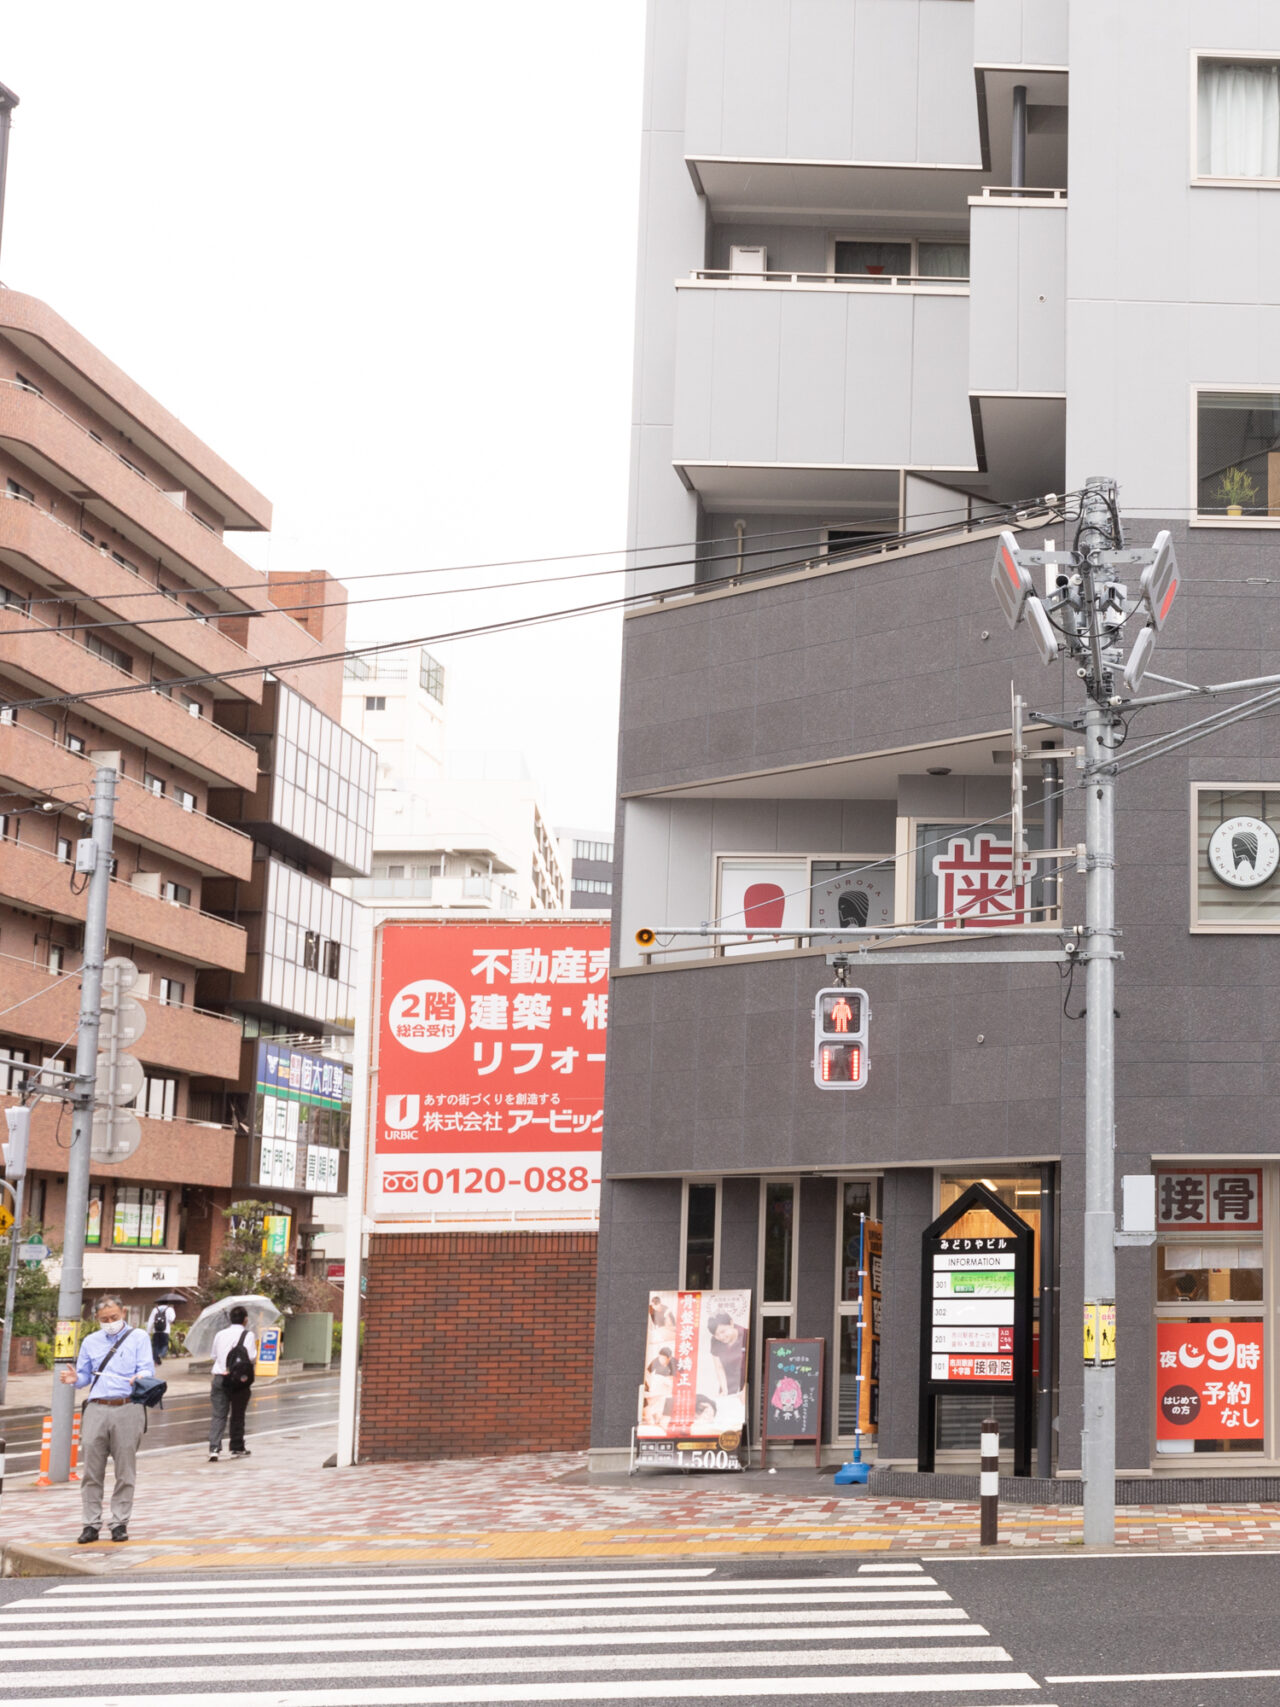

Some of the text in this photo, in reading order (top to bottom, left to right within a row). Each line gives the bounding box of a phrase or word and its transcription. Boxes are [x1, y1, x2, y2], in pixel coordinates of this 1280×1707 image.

[1221, 821, 1269, 838] AURORA
[1215, 847, 1275, 881] DENTAL CLINIC
[826, 880, 881, 897] AURORA
[938, 839, 1031, 929] 歯
[401, 992, 456, 1021] 2階
[396, 1024, 456, 1038] 総合受付
[424, 1093, 560, 1105] あすの街づくりを創造する
[423, 1111, 502, 1132] 株式会社
[384, 1131, 418, 1140] URBIC
[940, 1239, 1007, 1250] みどりやビル
[948, 1258, 1001, 1267] INFORMATION
[152, 1271, 165, 1281] POLA
[263, 1332, 277, 1343] P
[1160, 1351, 1177, 1368] 夜
[1206, 1328, 1260, 1370] 9時
[975, 1360, 1011, 1375] 接骨院
[1163, 1396, 1198, 1405] はじめて
[1202, 1382, 1251, 1405] 予約
[1172, 1405, 1190, 1415] の方
[1220, 1408, 1260, 1428] なし
